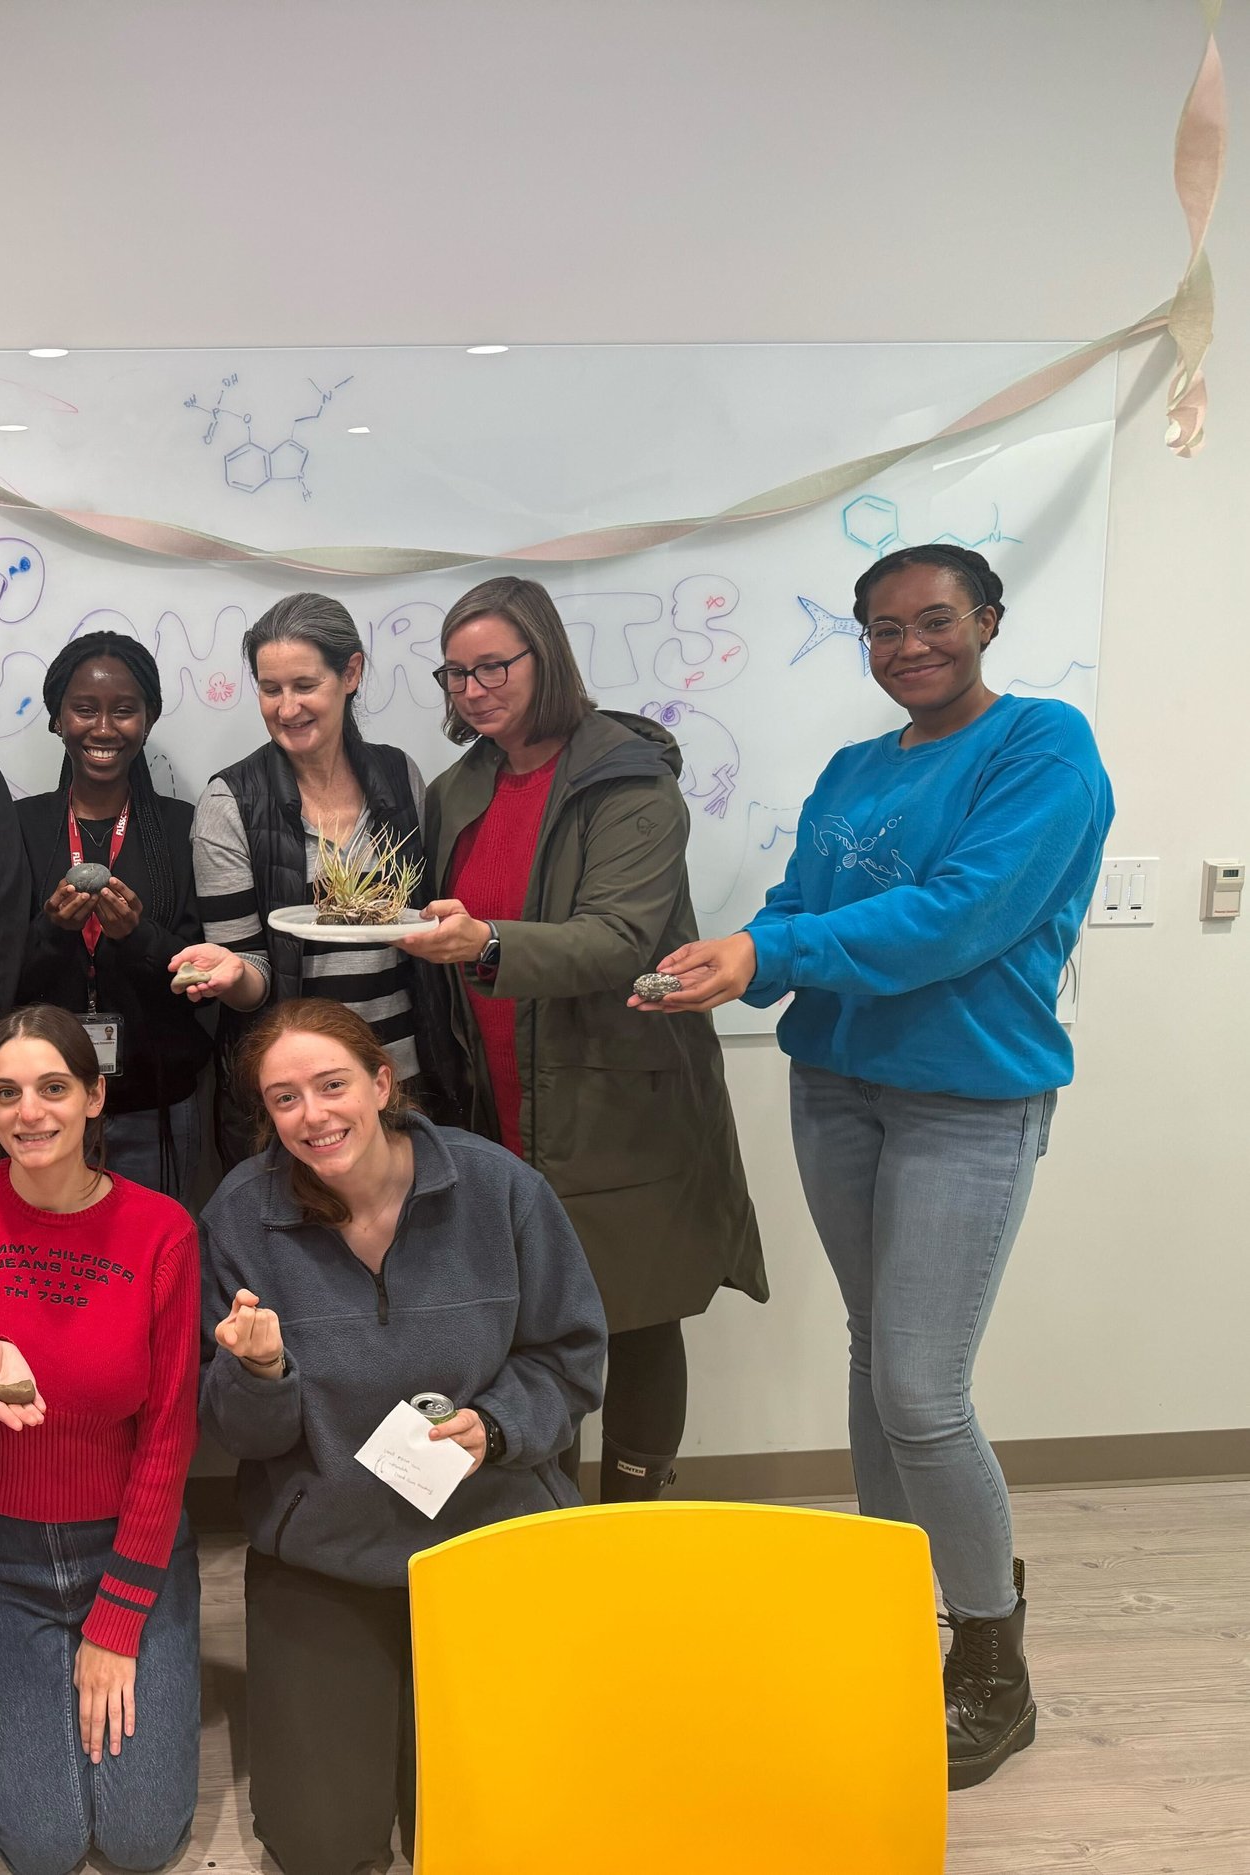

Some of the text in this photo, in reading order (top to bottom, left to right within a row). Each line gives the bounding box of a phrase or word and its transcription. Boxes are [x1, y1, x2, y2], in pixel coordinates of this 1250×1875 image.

[48, 1247, 136, 1284] HILFIGER
[70, 1265, 110, 1285] USA
[3, 1285, 89, 1308] TH 7342
